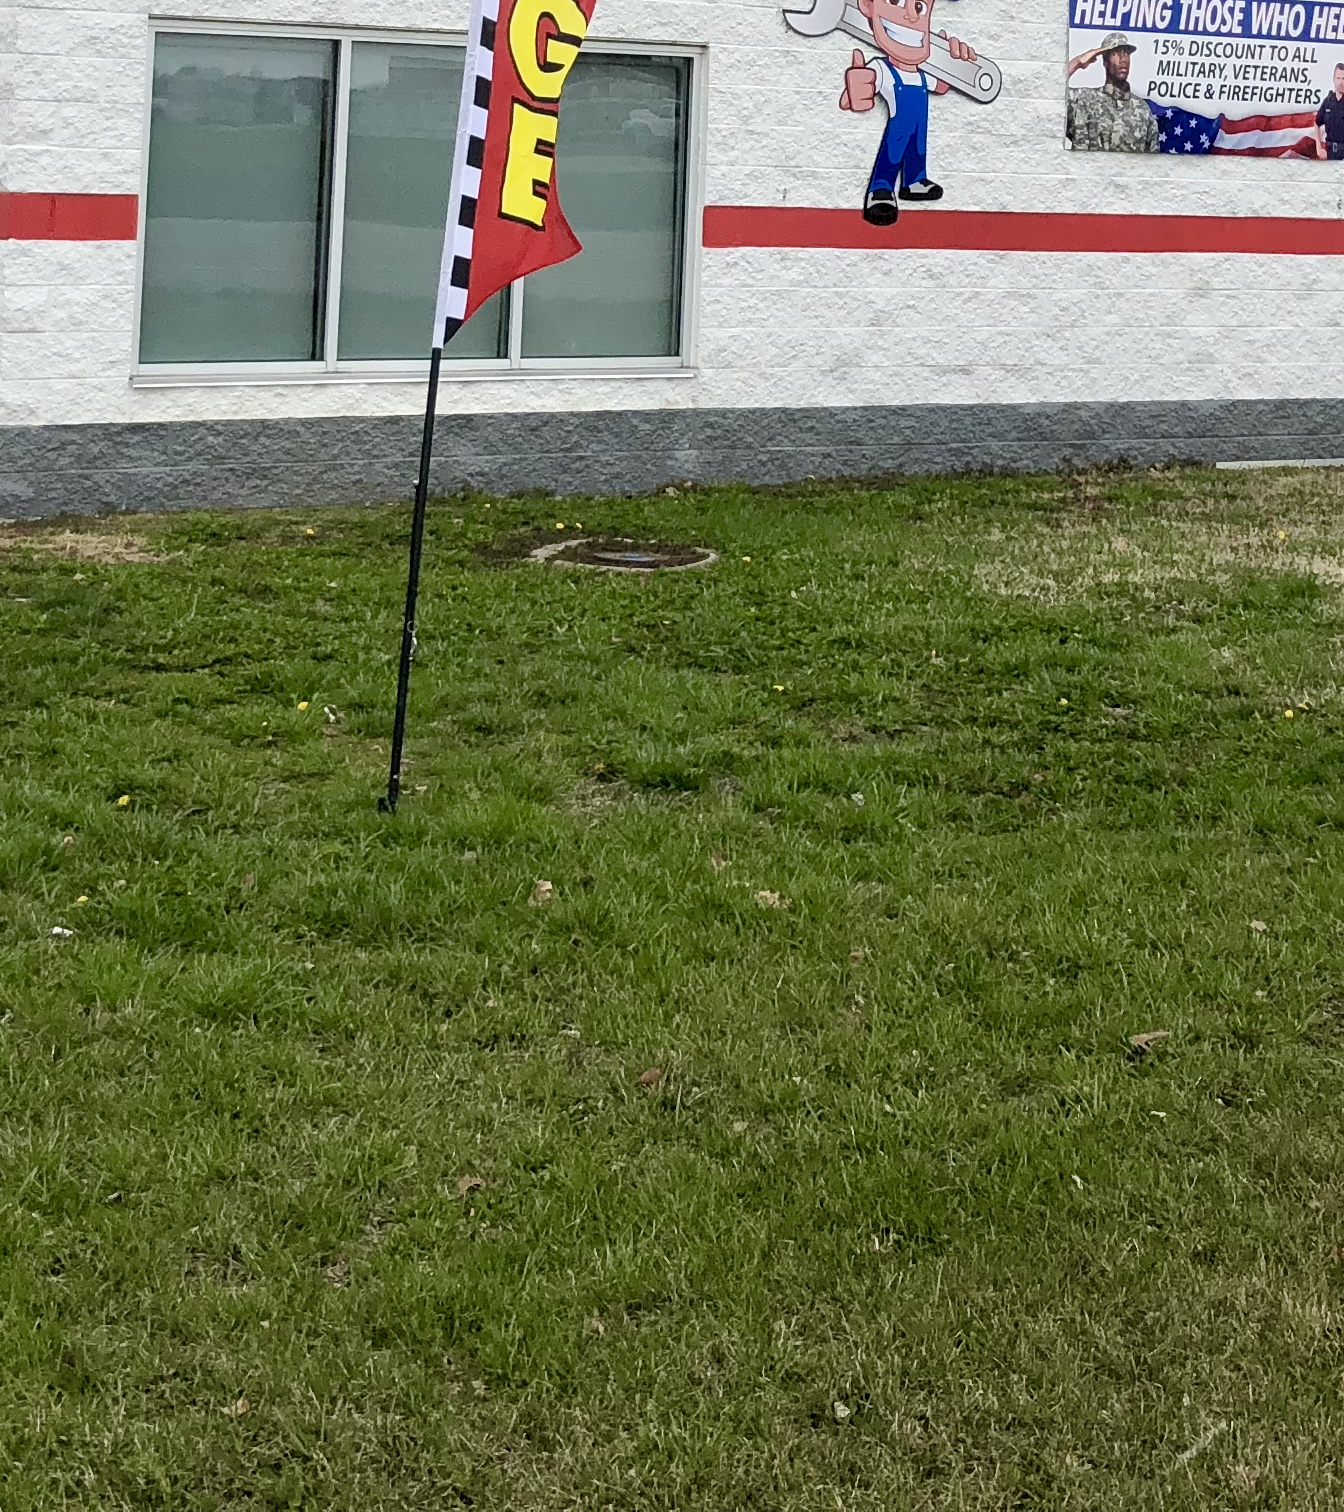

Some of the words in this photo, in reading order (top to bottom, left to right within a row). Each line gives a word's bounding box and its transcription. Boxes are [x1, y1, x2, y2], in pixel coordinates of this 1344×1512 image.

[1251, 0, 1307, 38] WHO
[1152, 38, 1185, 57] 15%
[1188, 40, 1266, 61] DISCOUNT
[1269, 45, 1289, 62] TO
[1291, 47, 1318, 64] ALL
[1156, 59, 1228, 82] MILITARY,
[1232, 64, 1312, 86] VETERANS,
[1146, 80, 1202, 99] POLICE
[1204, 83, 1215, 100] &
[1218, 84, 1322, 105] FIREFIGHTERS
